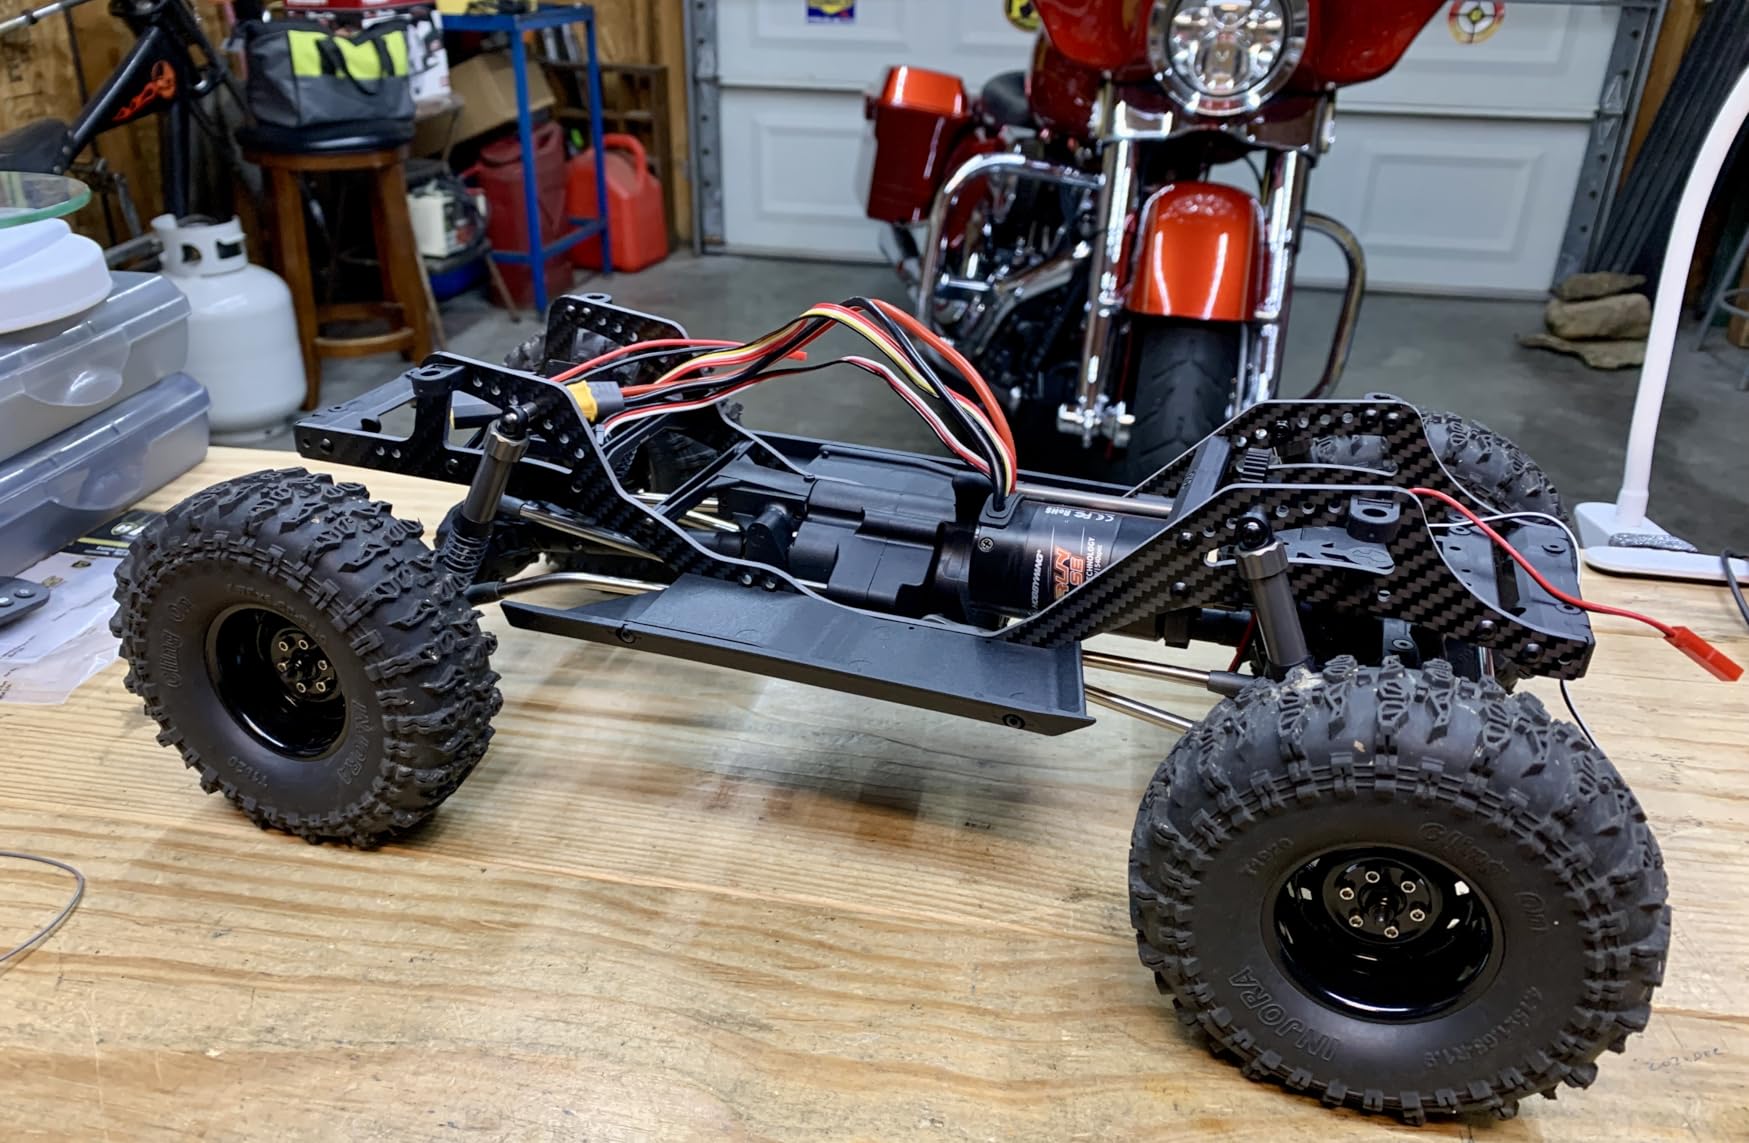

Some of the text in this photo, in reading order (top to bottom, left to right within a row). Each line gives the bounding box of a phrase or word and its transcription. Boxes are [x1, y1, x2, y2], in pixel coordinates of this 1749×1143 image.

[1044, 506, 1071, 517] RoHS
[336, 700, 375, 785] INJORA
[1228, 965, 1341, 1062] INJORA
